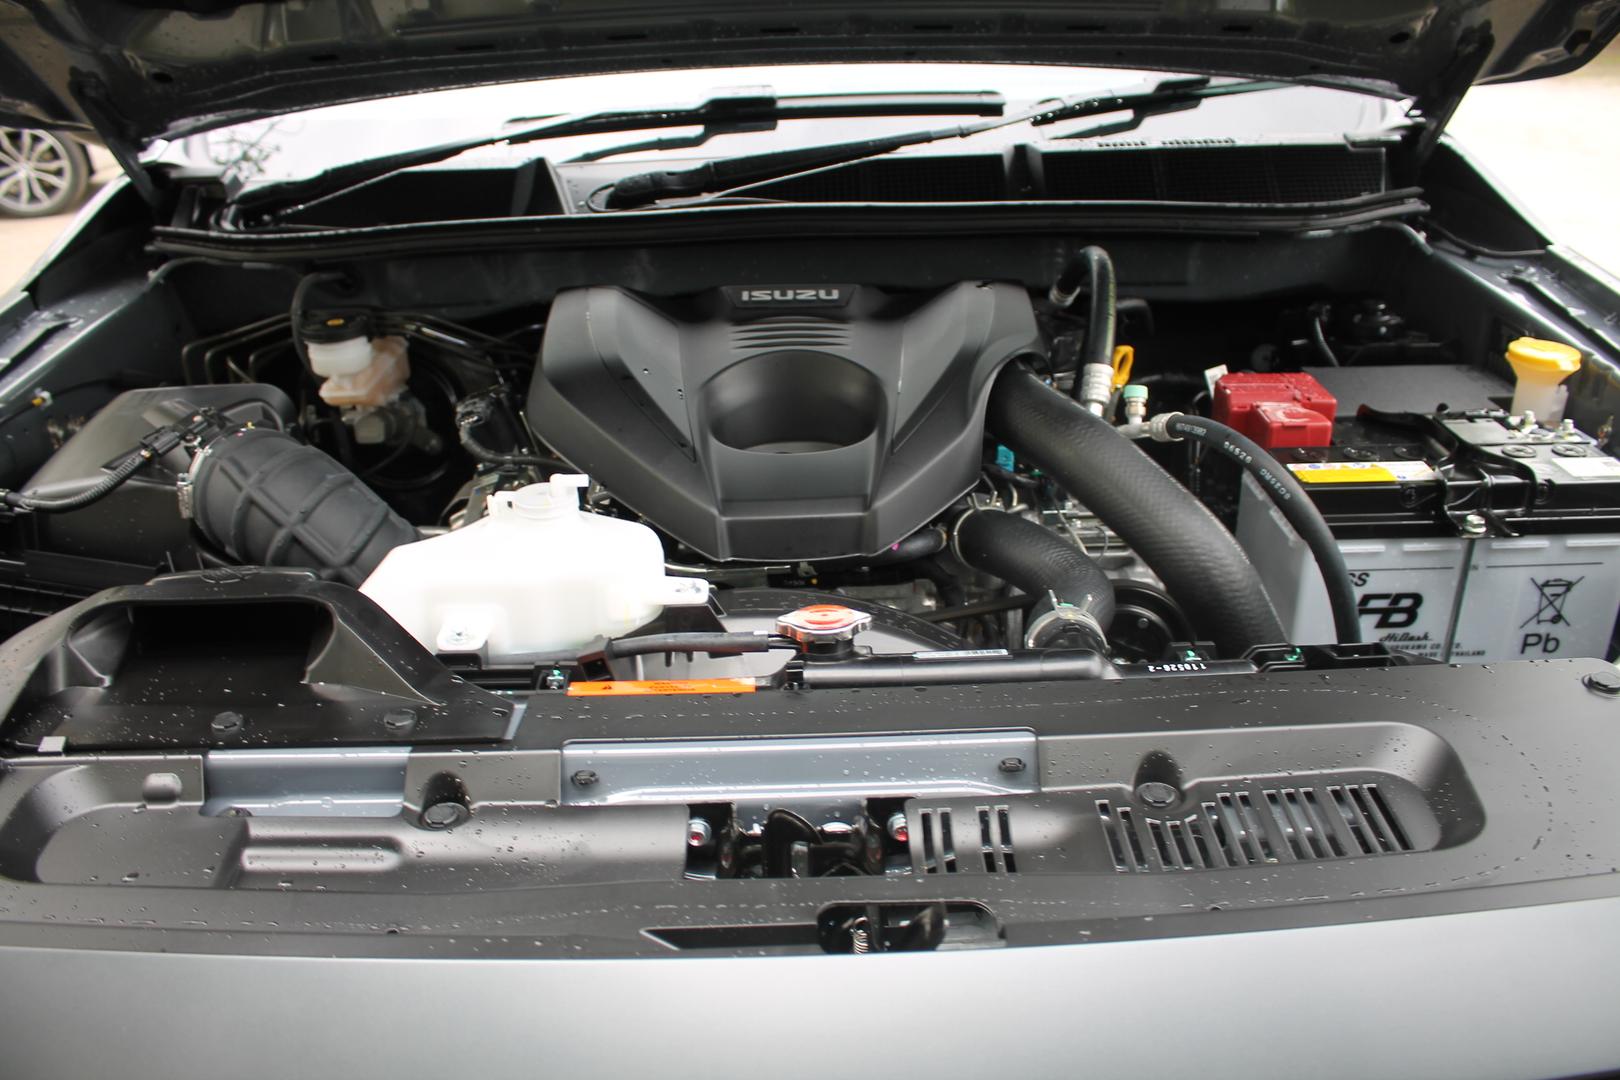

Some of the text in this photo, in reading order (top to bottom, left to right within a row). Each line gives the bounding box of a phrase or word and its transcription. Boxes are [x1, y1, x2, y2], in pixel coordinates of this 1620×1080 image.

[742, 290, 839, 301] ISUZU
[1357, 592, 1424, 629] FB
[1520, 633, 1560, 655] Pb
